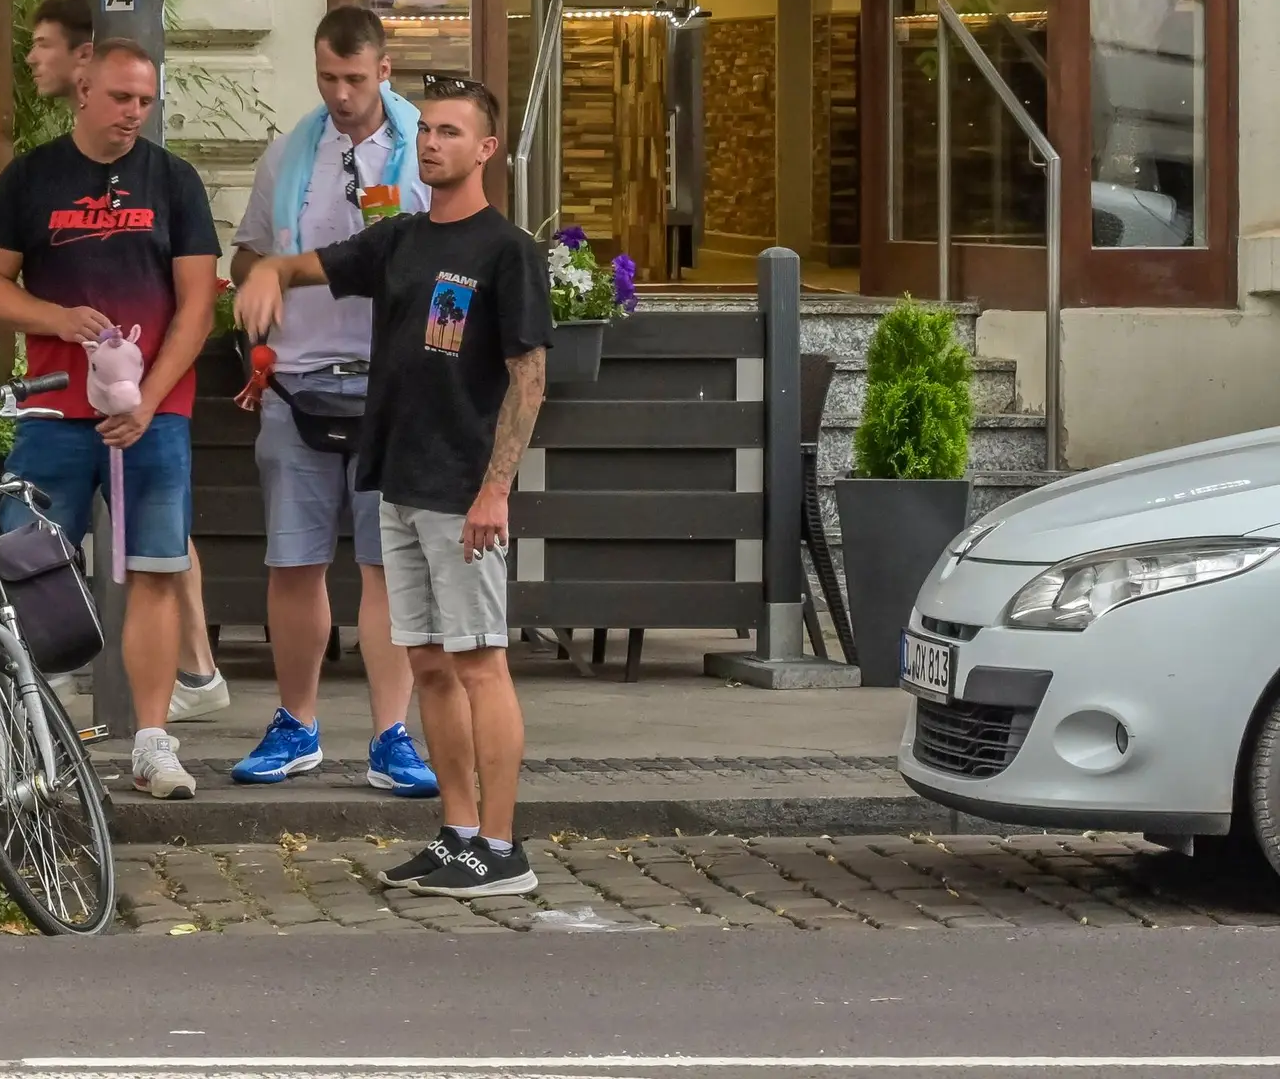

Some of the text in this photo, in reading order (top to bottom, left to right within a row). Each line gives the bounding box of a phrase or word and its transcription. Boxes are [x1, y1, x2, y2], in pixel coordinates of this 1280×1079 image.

[48, 208, 155, 230] HOLLISTER
[438, 271, 477, 287] MIAMI
[928, 647, 948, 687] 813
